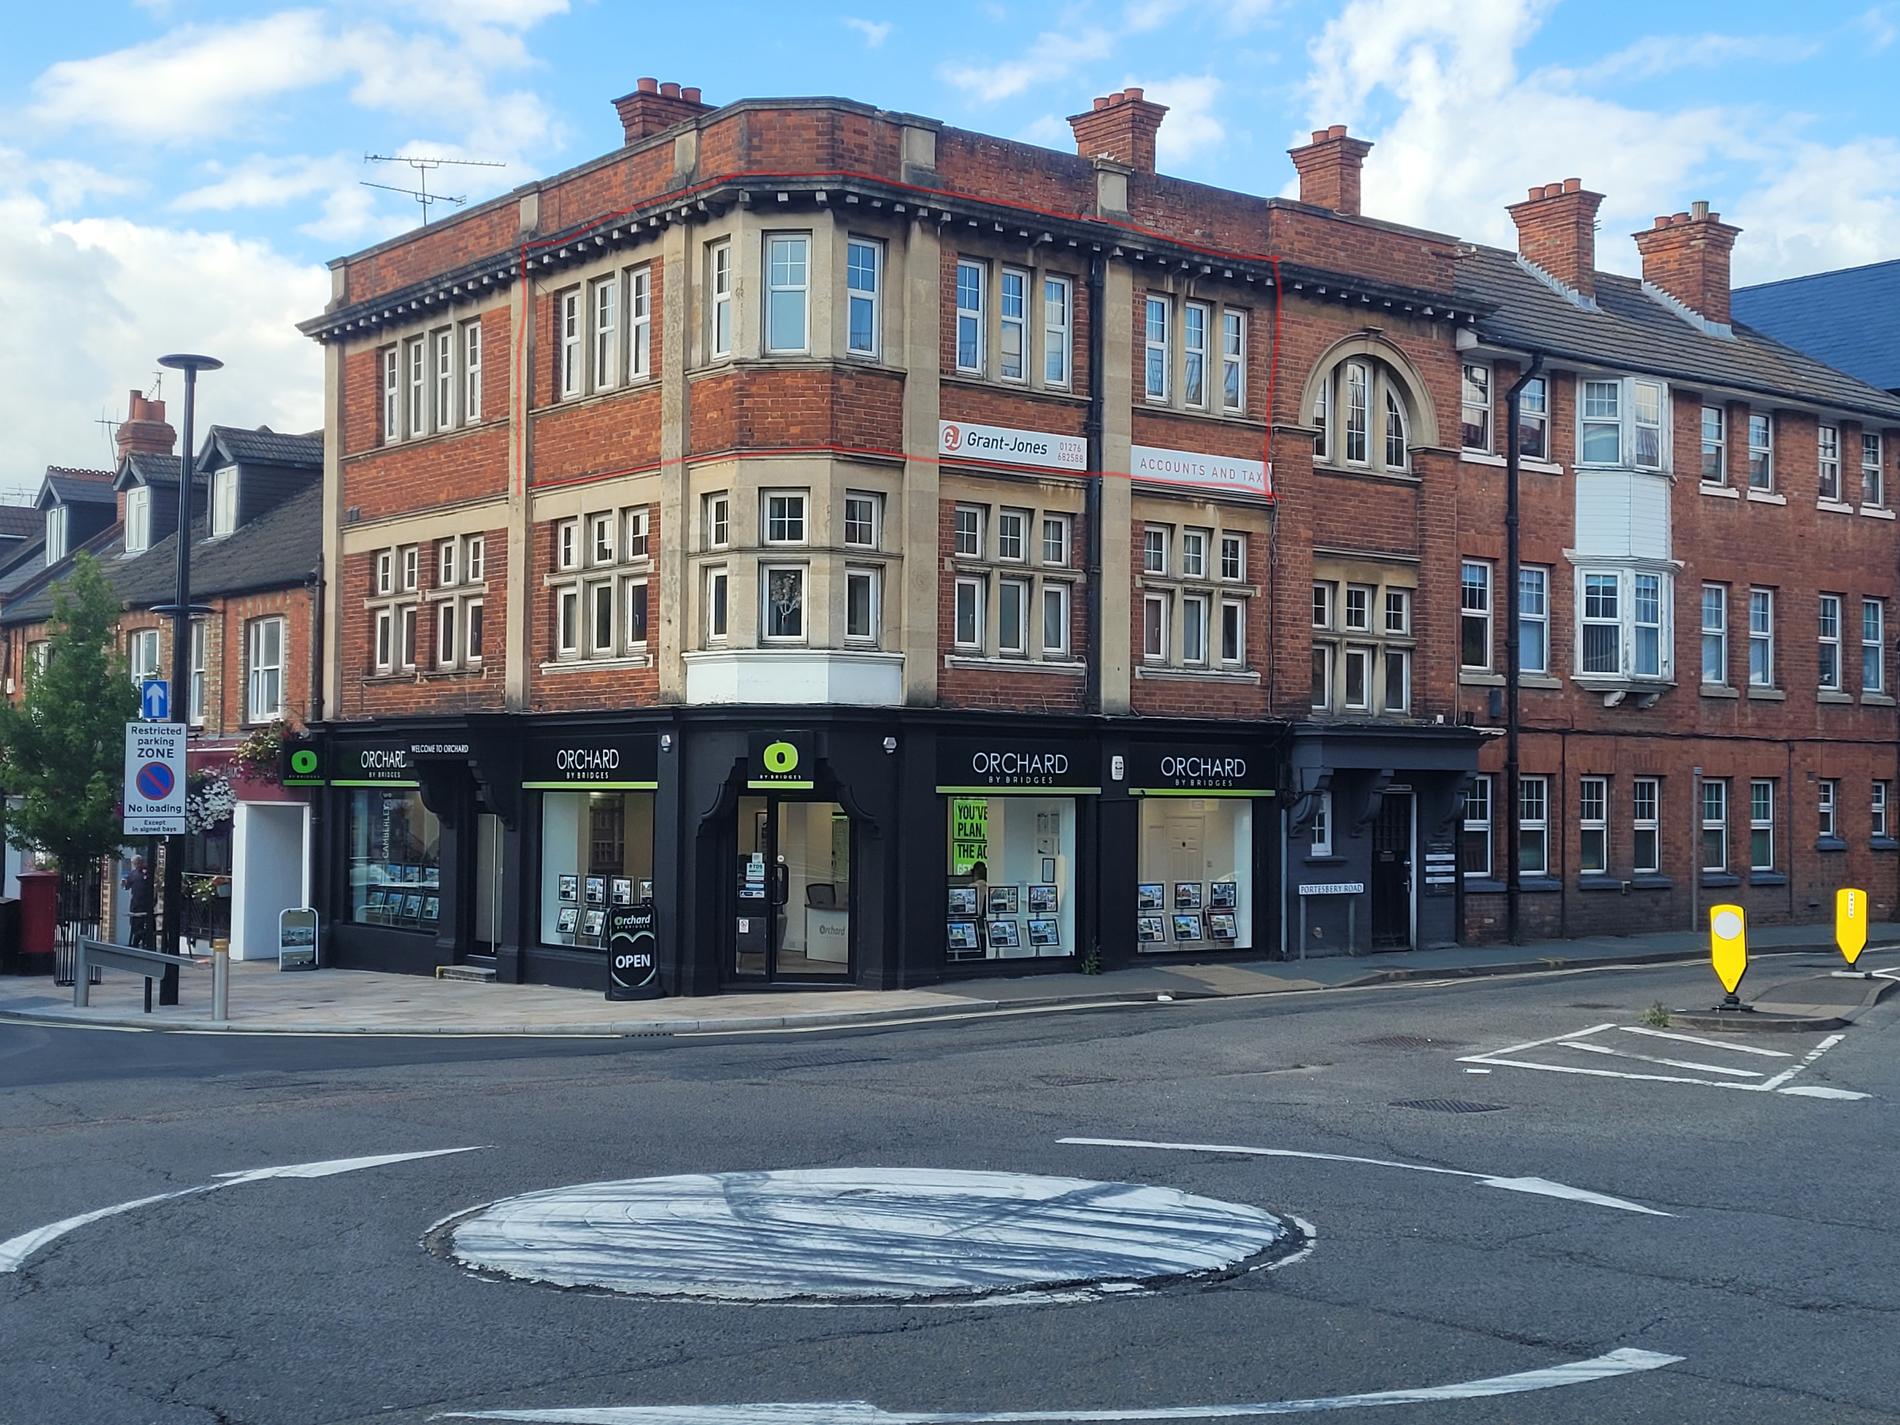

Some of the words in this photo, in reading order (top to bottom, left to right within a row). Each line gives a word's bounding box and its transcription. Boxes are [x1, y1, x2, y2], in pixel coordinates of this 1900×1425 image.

[967, 431, 1048, 455] Grant-Jones
[1059, 442, 1081, 453] 01276
[1140, 458, 1205, 476] ACCOUNTS
[1212, 466, 1236, 480] AND
[1242, 470, 1263, 483] TAX
[131, 726, 182, 735] Restricted
[137, 737, 174, 747] parking
[137, 748, 174, 758] ZONE
[411, 745, 435, 753] WELCOME
[443, 745, 469, 753] ORCHARD
[556, 749, 620, 770] ORCHARD
[972, 752, 1068, 774] ORCHARD
[1161, 756, 1246, 777] ORCHARD
[566, 771, 574, 779] BY
[577, 771, 609, 779] BRIDGES
[1006, 776, 1053, 784] BRIDGES
[1190, 779, 1232, 787] BRIDGES
[128, 804, 142, 813] No
[146, 804, 182, 814] loading
[957, 805, 988, 820] YOU'VE
[144, 819, 166, 827] Except
[957, 822, 986, 840] PLAN,
[957, 844, 975, 858] THE
[1344, 884, 1362, 892] ROAD
[614, 913, 651, 926] Orchard
[615, 953, 651, 969] OPEN
